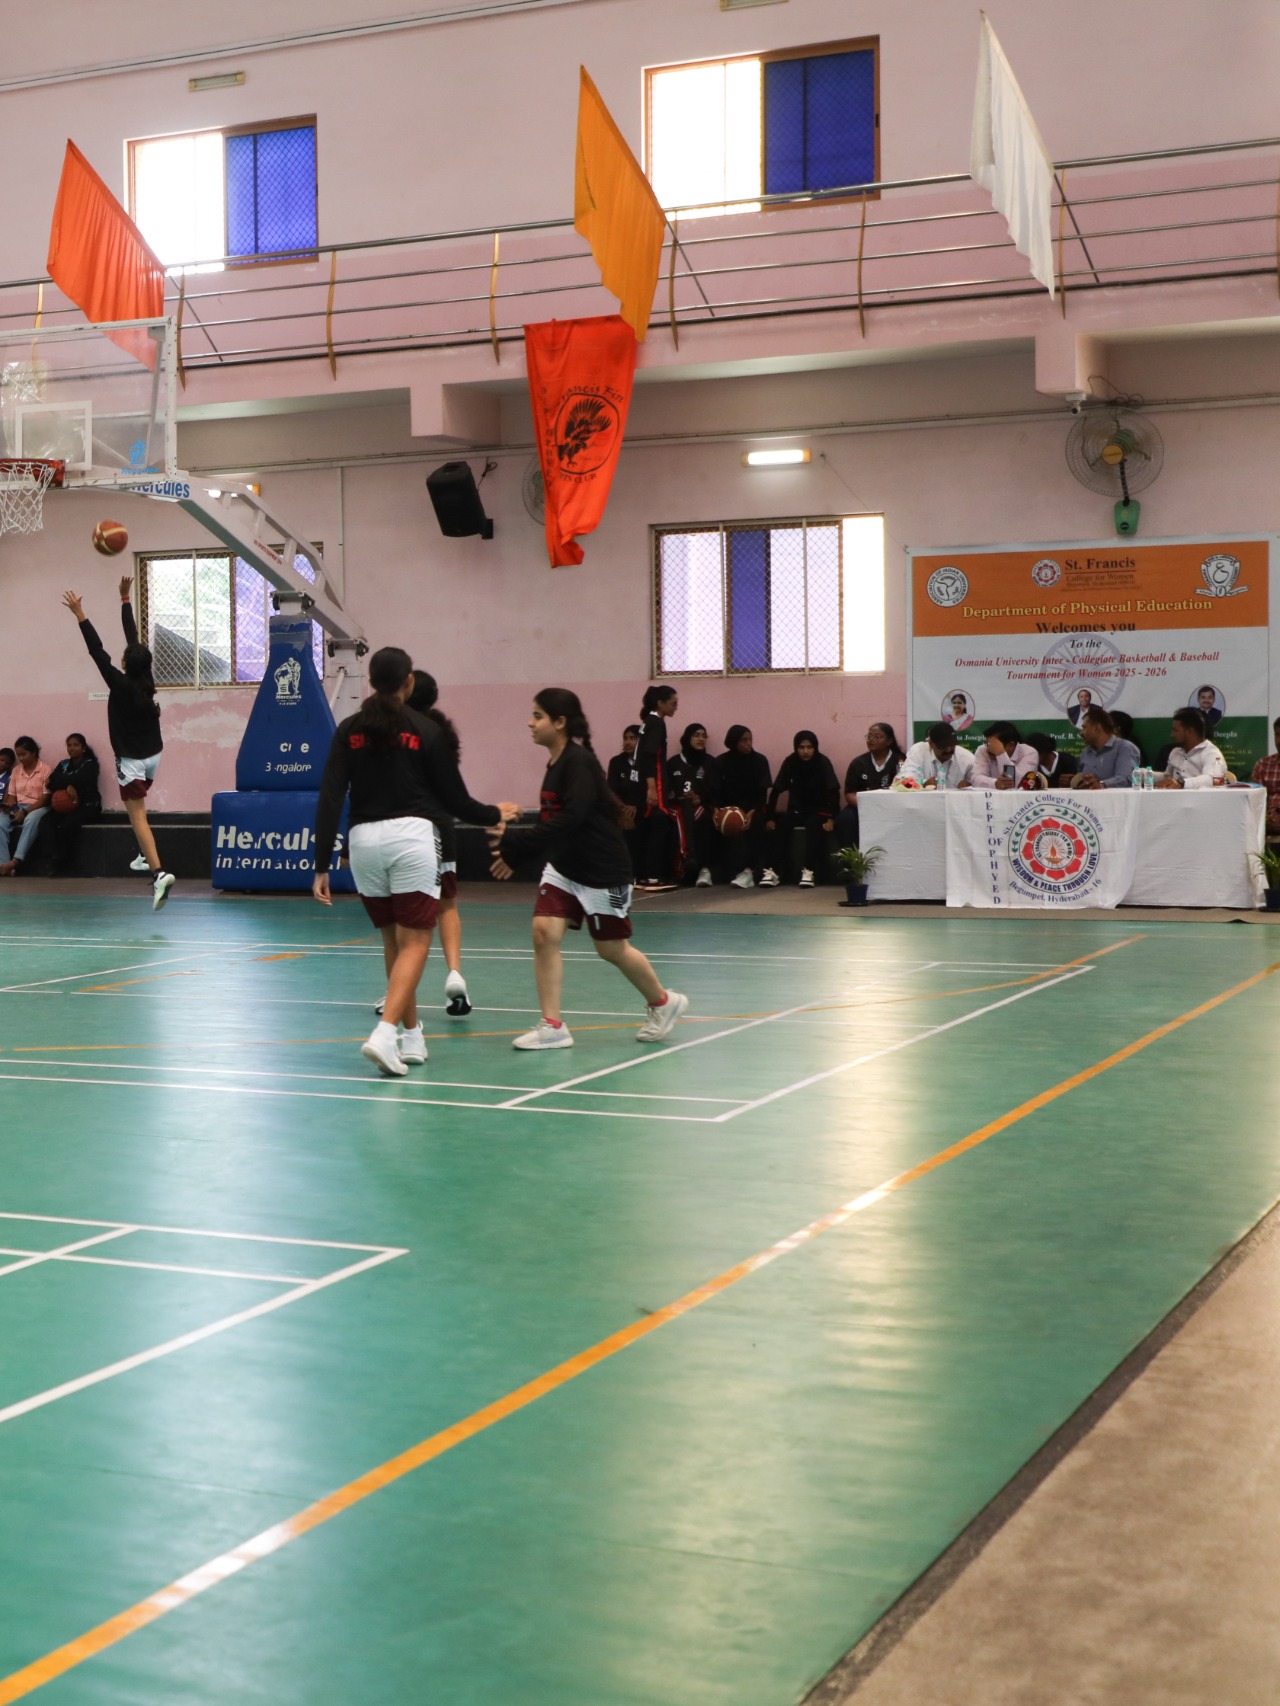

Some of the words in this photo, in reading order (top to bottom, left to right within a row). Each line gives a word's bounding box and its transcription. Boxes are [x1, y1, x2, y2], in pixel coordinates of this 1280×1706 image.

[1064, 560, 1082, 570] St.
[1086, 557, 1136, 570] Francis
[963, 605, 1048, 620] Department
[1052, 604, 1067, 615] of
[1070, 601, 1132, 615] Physical
[1135, 599, 1213, 612] Education
[1036, 622, 1106, 634] Welcomes
[1110, 624, 1136, 635] you
[1070, 639, 1083, 648] To
[1086, 639, 1102, 648] the
[955, 658, 992, 667] Osmania
[996, 657, 1040, 668] University
[1042, 656, 1064, 665] Inter
[1072, 654, 1116, 665] Collegiate
[1120, 652, 1166, 663] Basketball
[1169, 653, 1176, 662] &
[1180, 652, 1220, 662] Baseball
[1007, 670, 1060, 680] Tournament
[1060, 670, 1076, 680] for
[1078, 669, 1112, 678] Women
[1114, 668, 1136, 677] 2025
[1145, 668, 1167, 676] 2026
[684, 781, 692, 792] 3
[1003, 825, 1012, 836] St.
[1010, 801, 1034, 824] Francis
[1035, 794, 1066, 804] College
[1068, 798, 1082, 810] For
[1084, 806, 1104, 832] Women
[988, 838, 1003, 846] OF
[1012, 858, 1034, 884] WISDOM
[1040, 882, 1062, 892] PEACE
[1062, 870, 1091, 891] THROUGH
[1087, 852, 1098, 870] LOVE
[1010, 880, 1046, 902] Begumpet,
[1048, 889, 1090, 904] Hyderabad
[1092, 878, 1102, 888] 16
